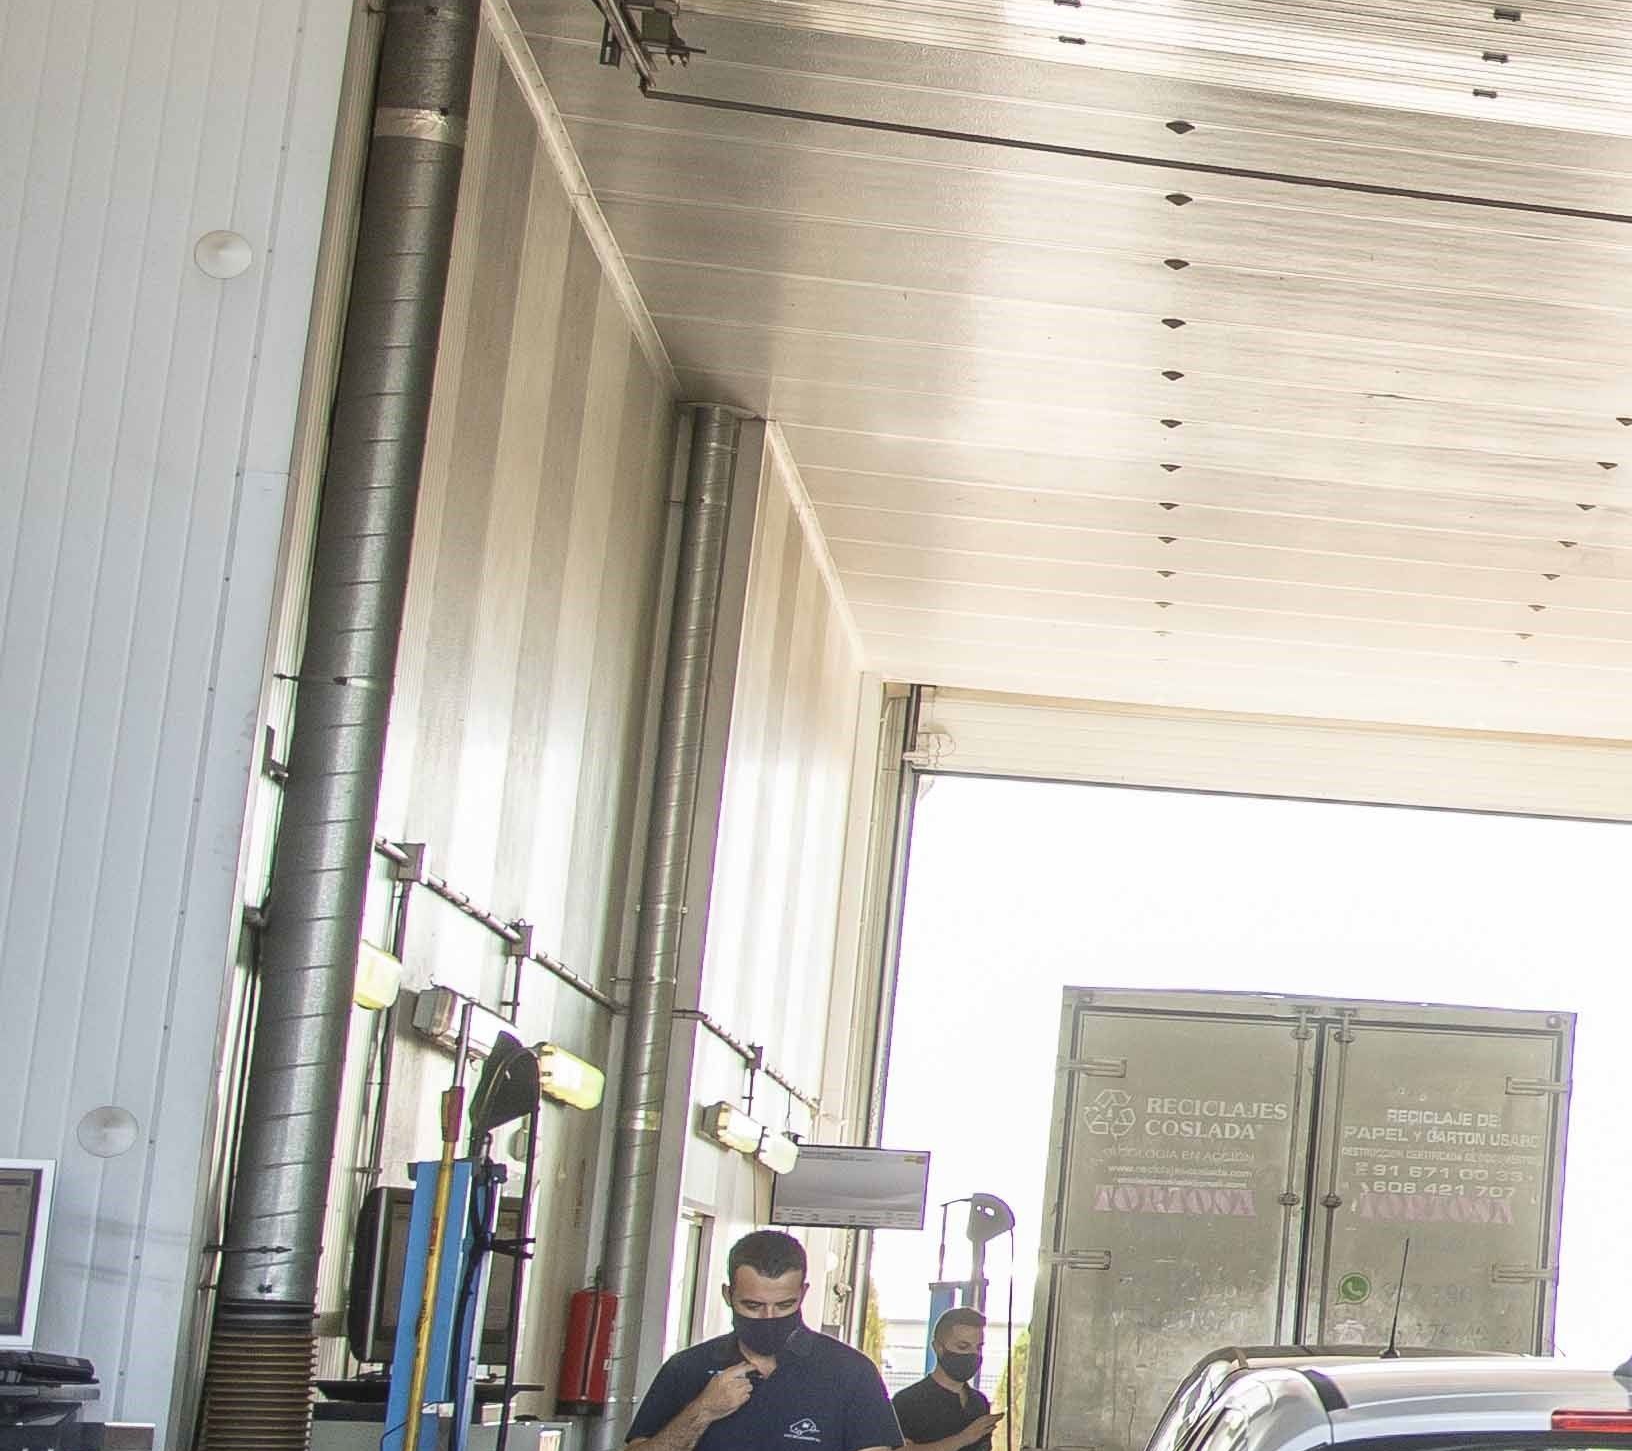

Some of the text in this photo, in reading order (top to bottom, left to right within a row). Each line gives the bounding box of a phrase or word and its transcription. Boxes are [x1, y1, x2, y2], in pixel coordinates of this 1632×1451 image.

[1146, 1096, 1289, 1120] RECICLAJES
[1387, 1109, 1473, 1127] RECICLAJE
[1144, 1118, 1257, 1141] COSLADA
[1344, 1125, 1409, 1143] PAPEL
[1372, 1181, 1417, 1194] 608
